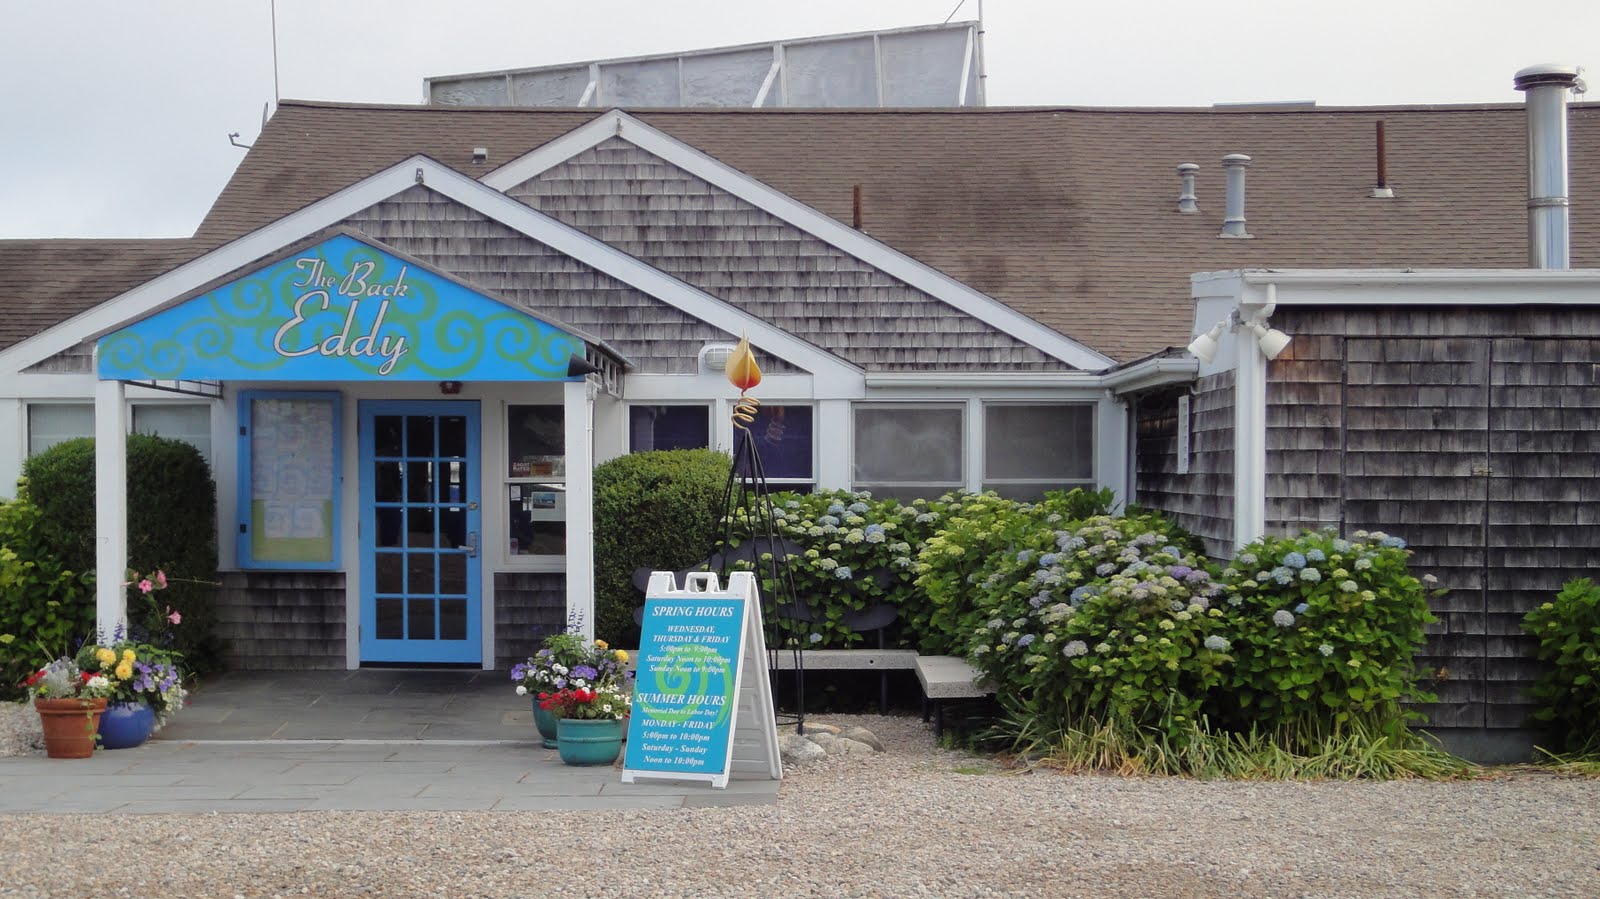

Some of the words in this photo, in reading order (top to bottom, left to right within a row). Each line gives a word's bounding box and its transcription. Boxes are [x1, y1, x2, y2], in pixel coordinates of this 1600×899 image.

[293, 258, 336, 287] The
[338, 261, 408, 297] Back
[273, 289, 409, 376] Eddy
[652, 606, 693, 617] SPRING
[695, 607, 734, 617] HOURS
[694, 635, 700, 643] &
[701, 635, 730, 643] FRIDAY
[659, 645, 684, 653] 5:00pm
[646, 655, 675, 663] Saturday
[703, 655, 731, 665] 10:00pm
[649, 664, 674, 673] Sunday
[692, 665, 700, 673] to
[636, 693, 685, 704] SUMMER
[687, 695, 727, 705] HOURS
[641, 719, 678, 728] MONDAY
[682, 720, 715, 729] FRIDAY
[642, 731, 668, 741] 5:00pm
[679, 732, 710, 742] 10:00pm
[641, 743, 674, 753] Saturday
[680, 744, 708, 755] Sunday
[643, 755, 663, 763] Noon
[664, 756, 672, 764] to
[674, 756, 705, 767] 10:00pm
